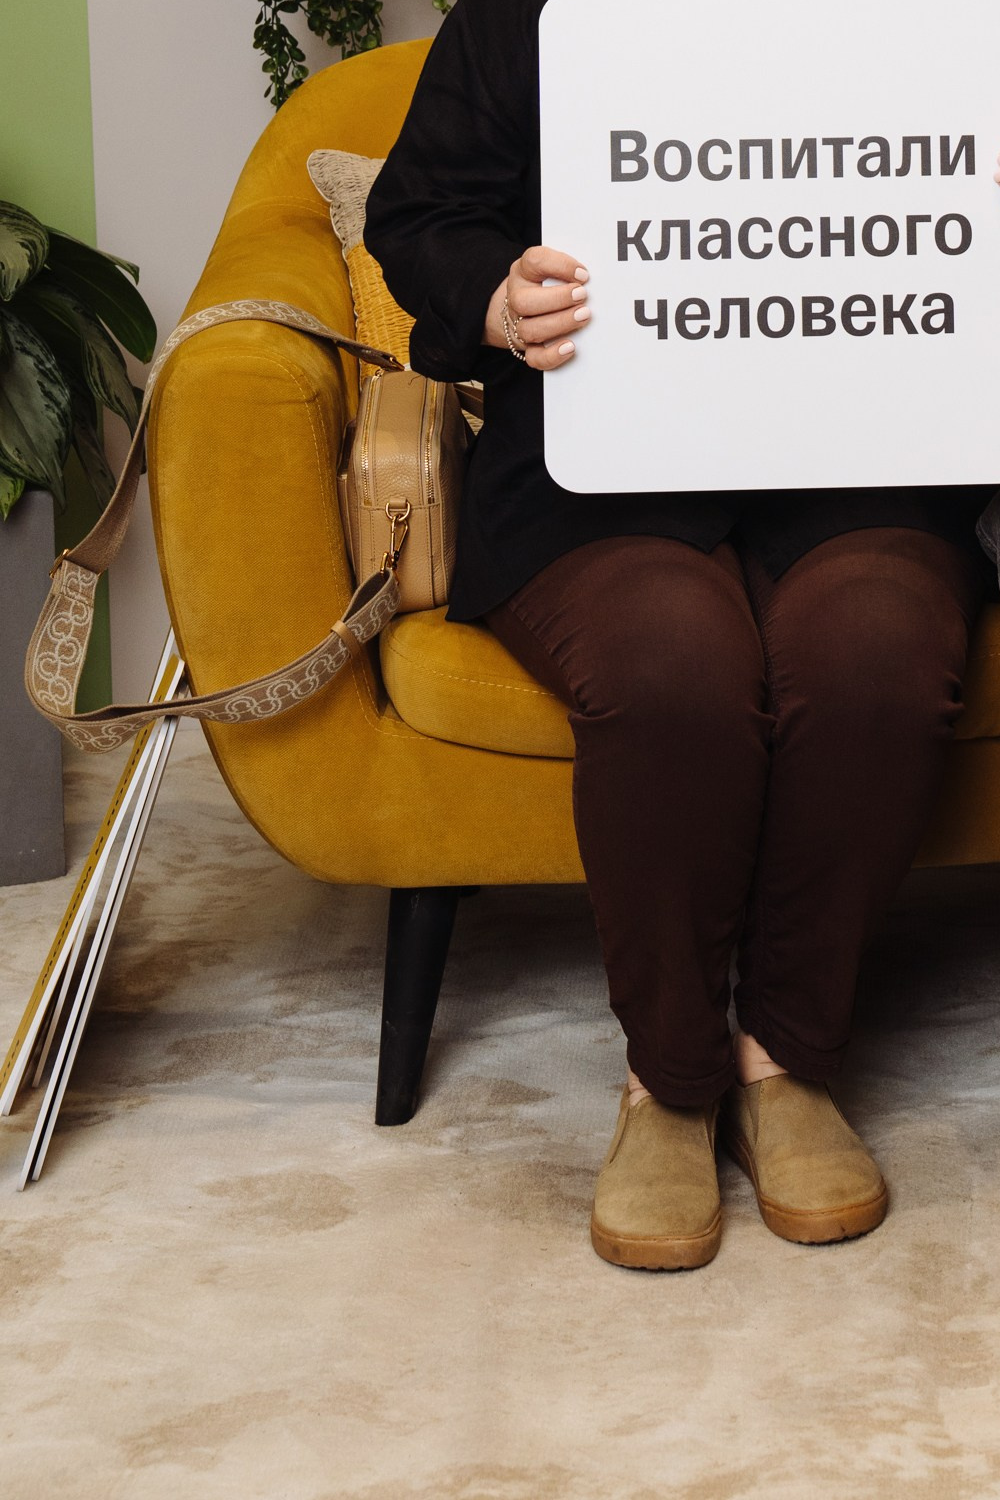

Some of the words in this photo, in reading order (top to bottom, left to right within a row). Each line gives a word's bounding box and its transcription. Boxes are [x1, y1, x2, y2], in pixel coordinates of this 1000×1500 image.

[609, 129, 977, 184] Воспитали
[616, 212, 974, 262] классного
[633, 291, 956, 341] человека
